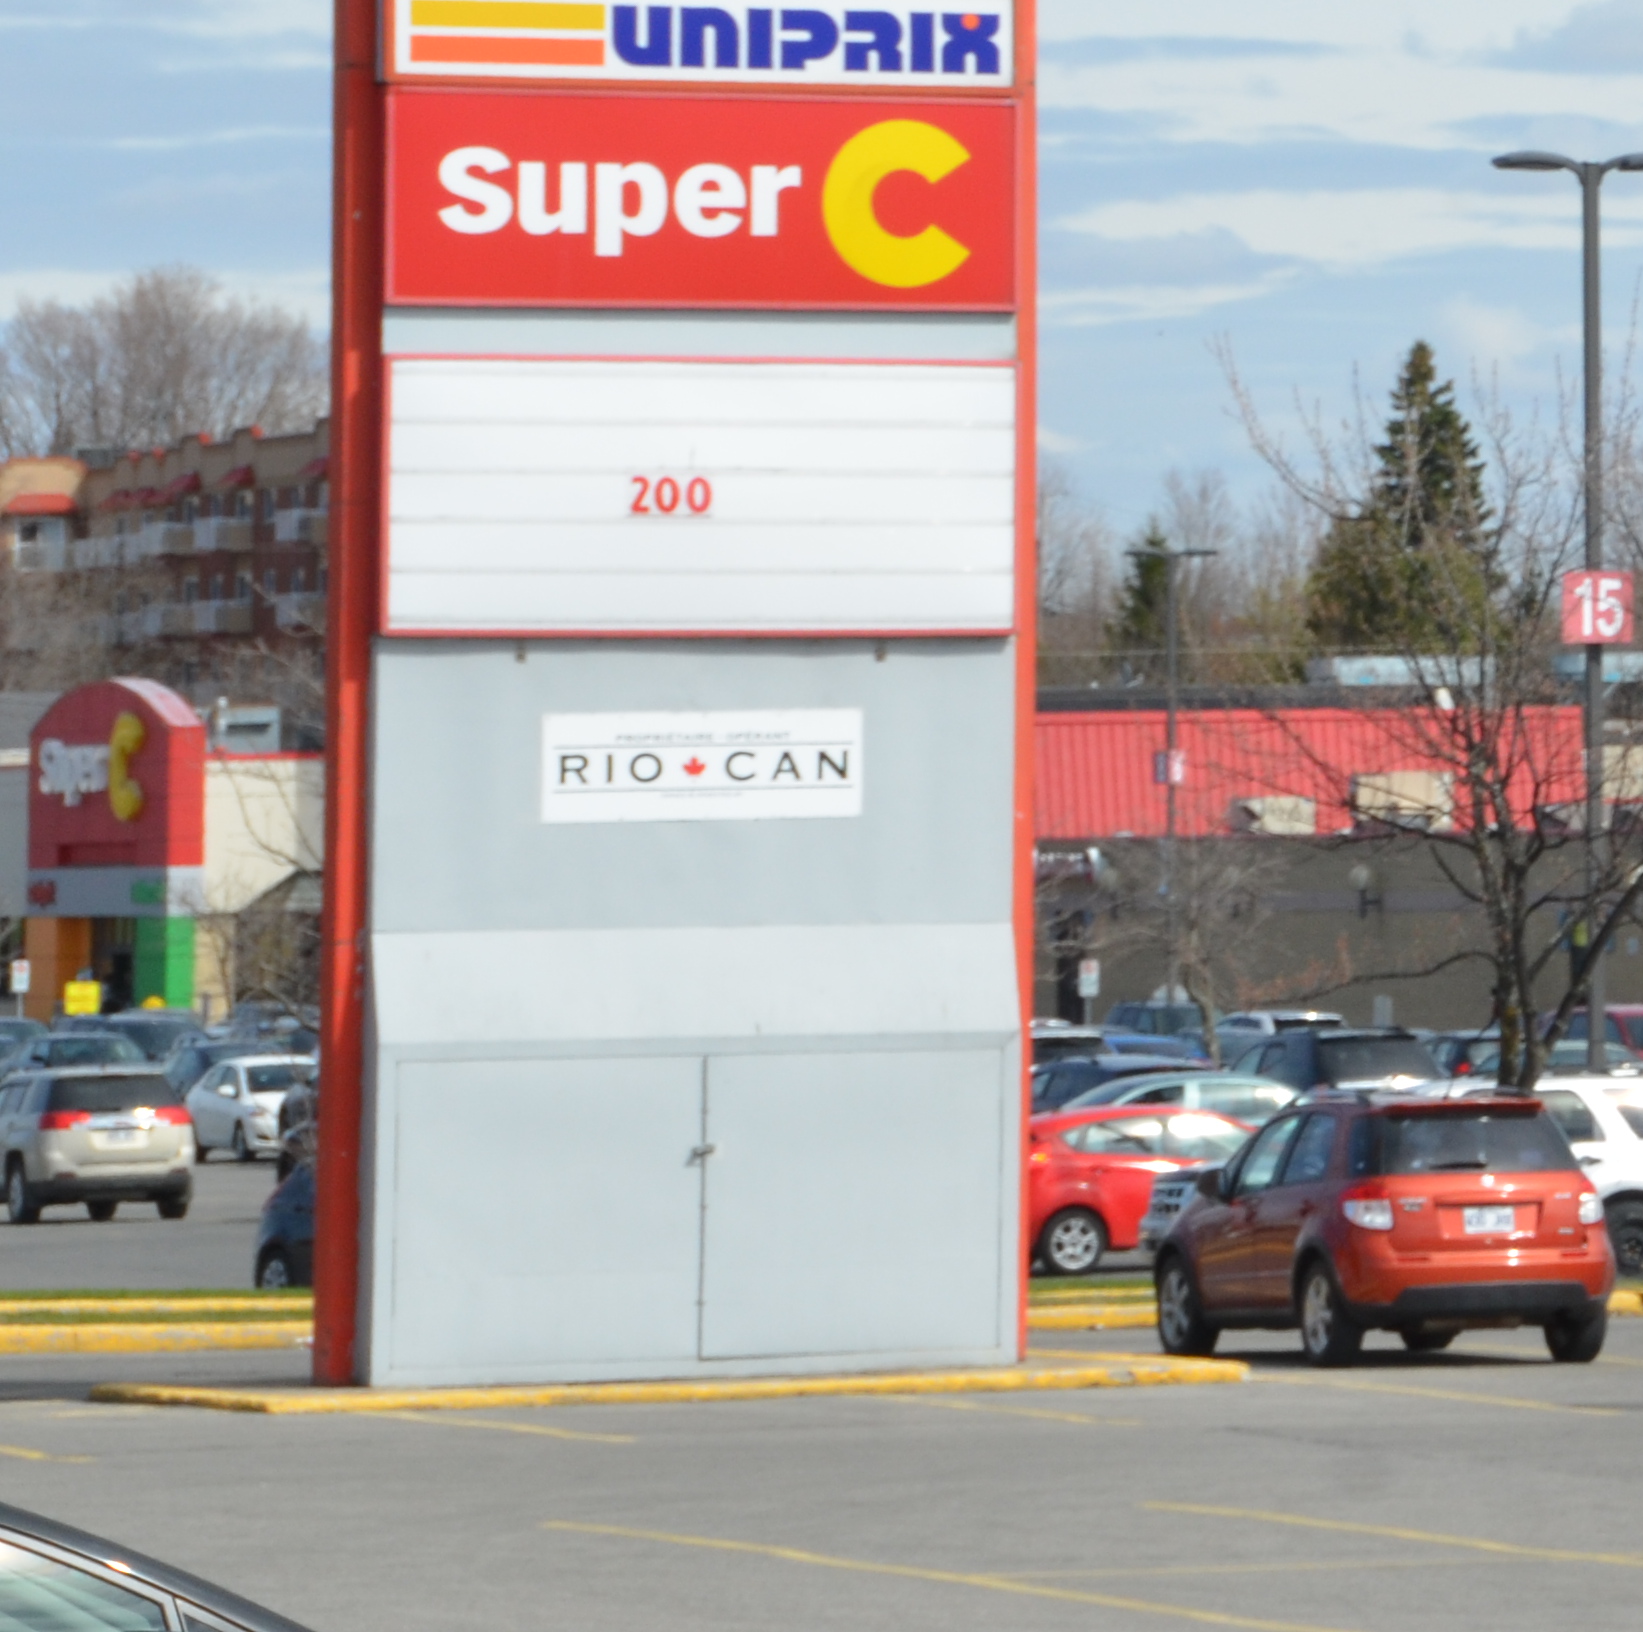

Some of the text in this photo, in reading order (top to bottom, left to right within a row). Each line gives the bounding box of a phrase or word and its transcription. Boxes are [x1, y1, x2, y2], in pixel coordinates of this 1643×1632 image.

[611, 4, 1001, 76] UNIPRIX
[437, 118, 972, 289] Super C
[629, 475, 713, 515] 200
[1573, 577, 1625, 638] 15
[558, 749, 849, 785] RIO CAN
